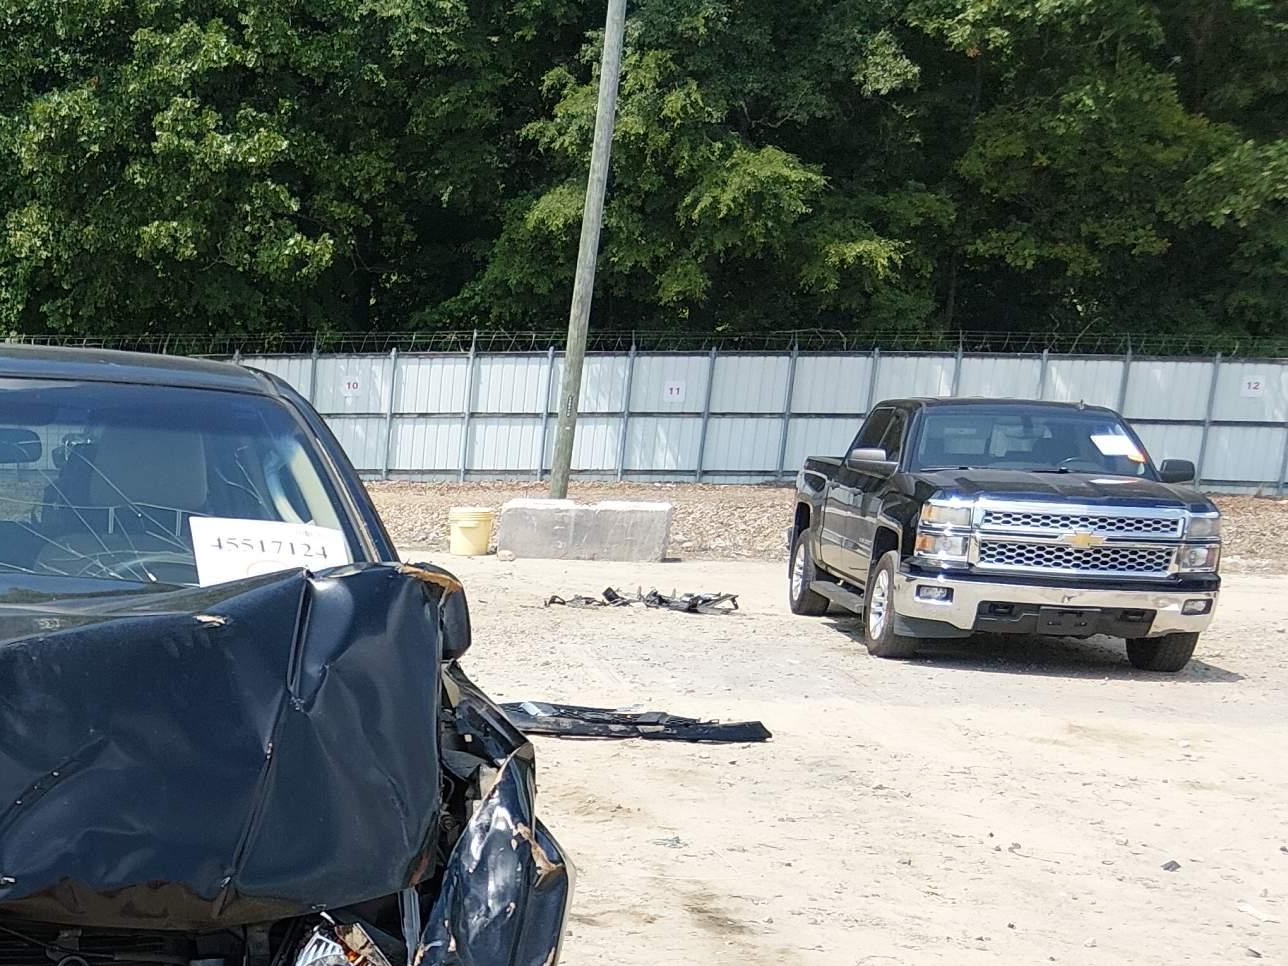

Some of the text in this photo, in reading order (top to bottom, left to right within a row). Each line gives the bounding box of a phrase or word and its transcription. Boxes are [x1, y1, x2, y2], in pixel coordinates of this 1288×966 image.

[346, 381, 360, 390] 10
[1247, 381, 1261, 391] 12
[669, 386, 680, 396] 11
[211, 536, 328, 559] 45517124
